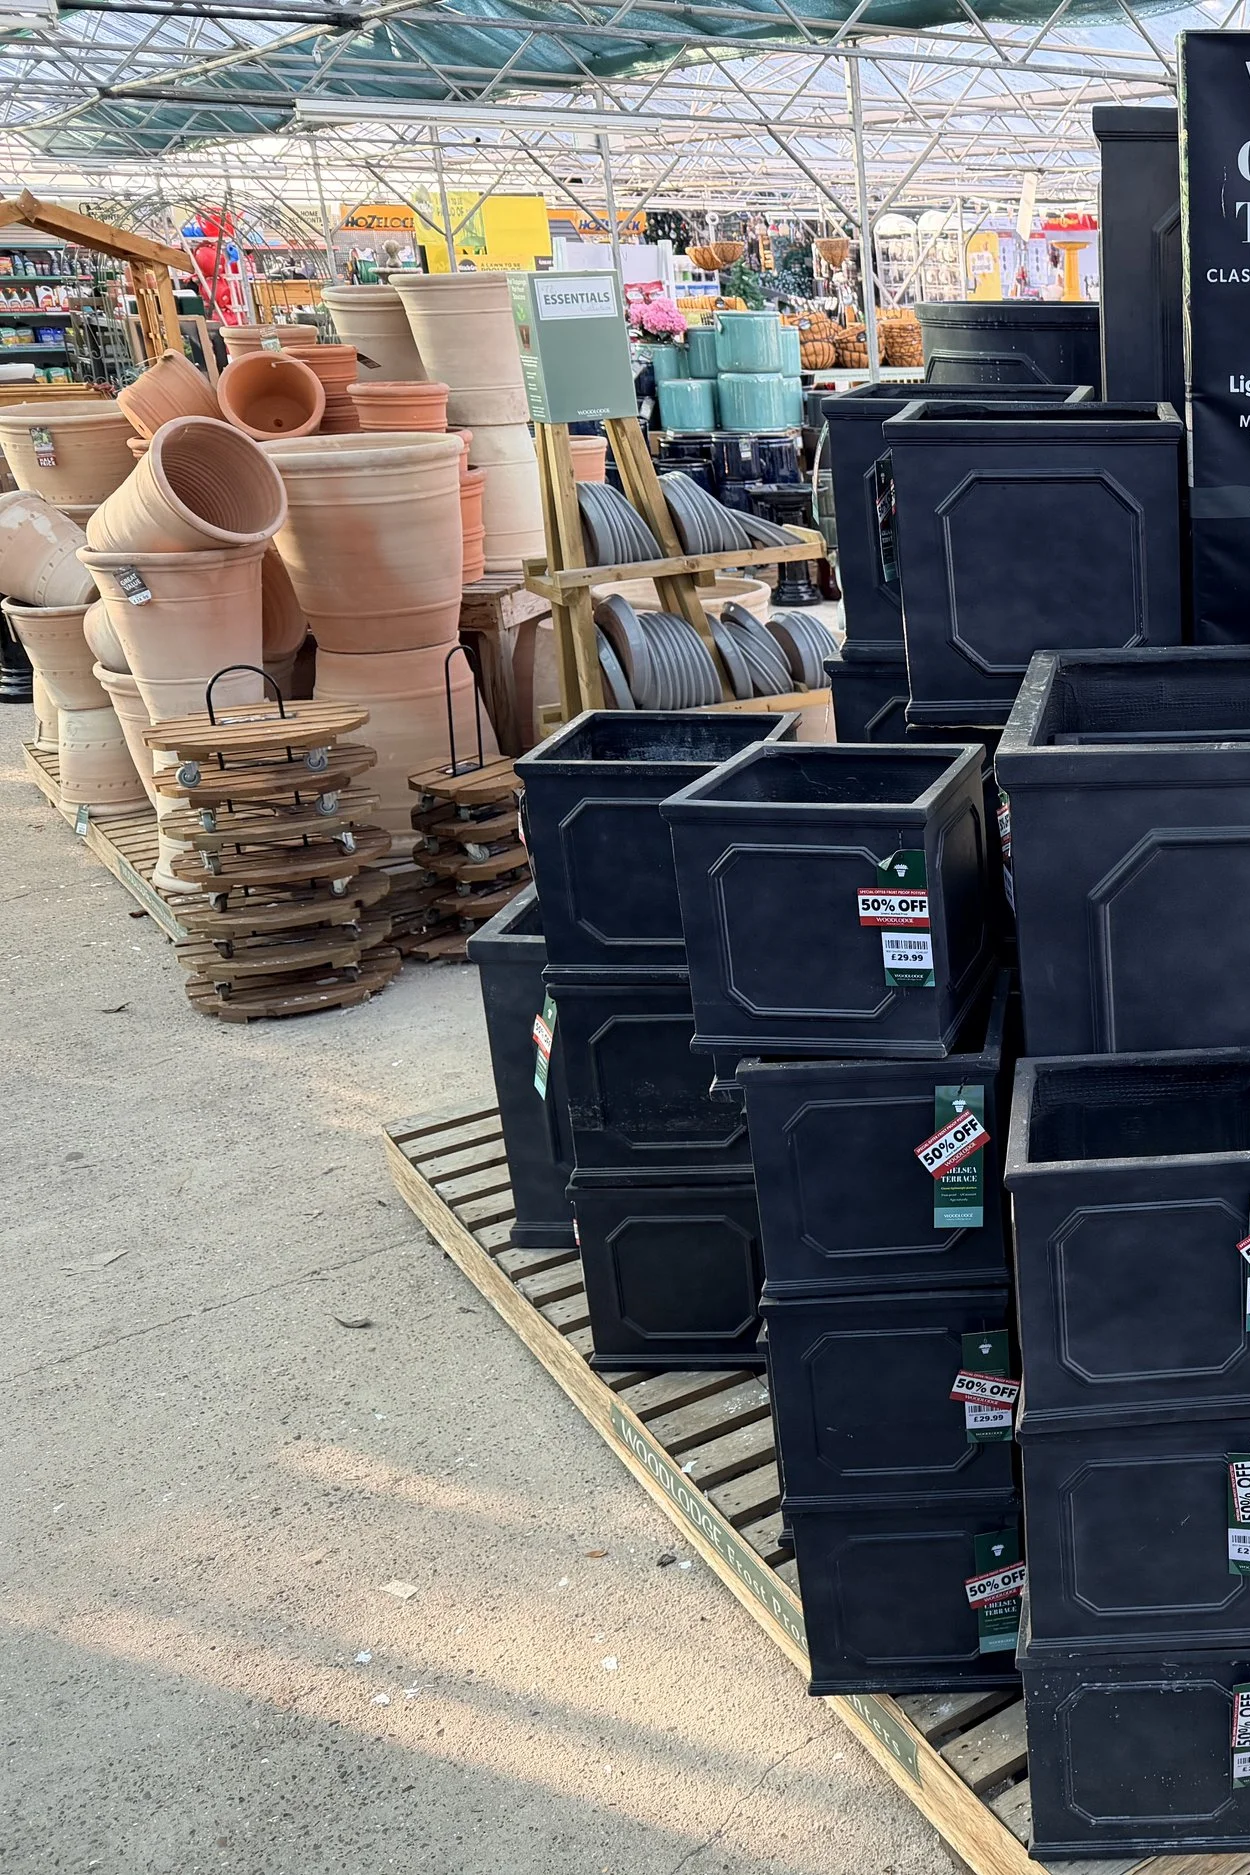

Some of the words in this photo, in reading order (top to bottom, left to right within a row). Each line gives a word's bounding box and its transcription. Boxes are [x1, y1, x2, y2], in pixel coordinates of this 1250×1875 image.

[543, 291, 610, 305] ESSENTIALS
[120, 573, 138, 586] GREAT
[123, 578, 142, 591] VALUE
[861, 898, 895, 912] 50%
[898, 899, 927, 912] OFF
[891, 954, 924, 962] £29.99
[923, 1139, 955, 1166] 50%
[953, 1118, 978, 1142] OFF
[941, 1175, 977, 1183] TERRACE
[956, 1379, 987, 1393] 50%
[990, 1385, 1017, 1398] OFF
[974, 1415, 1004, 1423] £29.99
[621, 1419, 724, 1552] WOODLODGE
[727, 1545, 767, 1604] Frost
[772, 1596, 808, 1648] Proo
[969, 1579, 999, 1597] 50%
[1002, 1569, 1025, 1586] OFF
